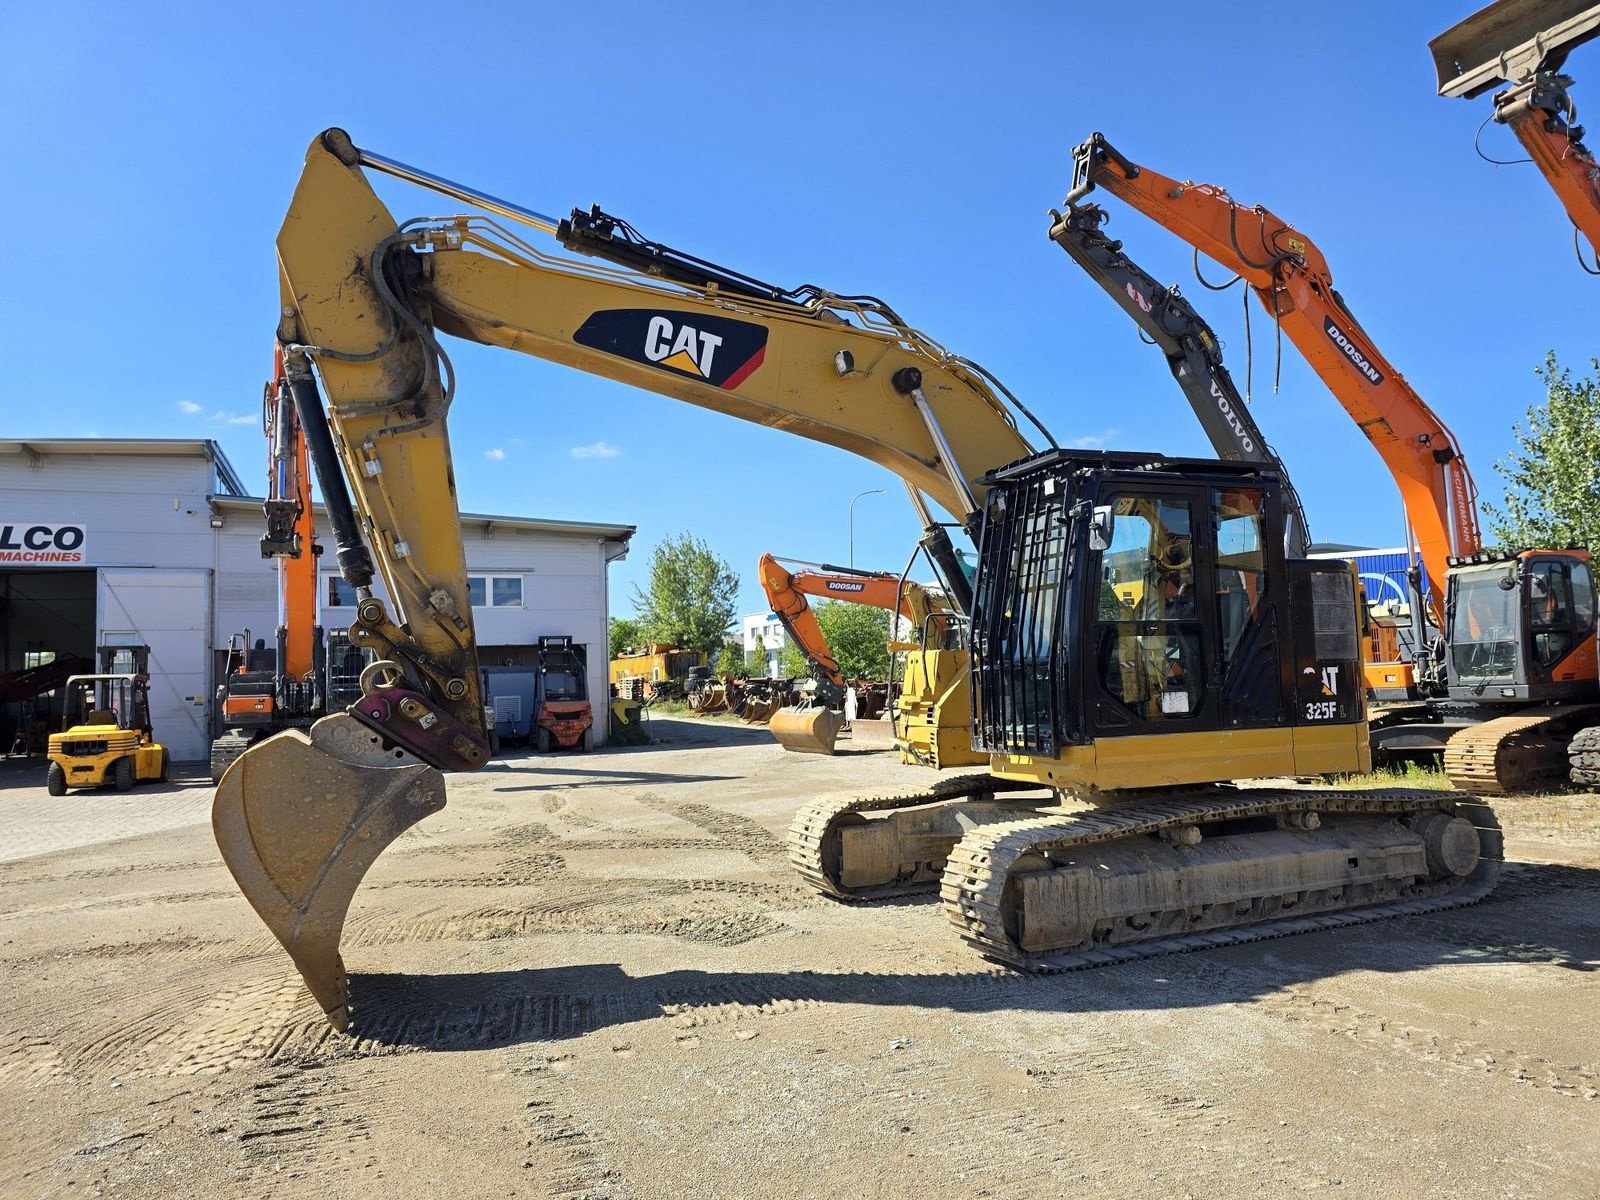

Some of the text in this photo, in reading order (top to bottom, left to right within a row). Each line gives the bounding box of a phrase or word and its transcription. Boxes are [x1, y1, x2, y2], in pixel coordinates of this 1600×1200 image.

[644, 316, 723, 378] CAT
[1327, 325, 1379, 381] DOOSAN
[1210, 379, 1253, 453] VOLVO
[1453, 470, 1471, 543] SCHERMANN
[0, 525, 84, 550] LCO
[0, 552, 81, 562] MACHINES
[829, 582, 862, 591] DOOSAN
[1303, 666, 1339, 695] AT
[1306, 701, 1337, 720] 325F
